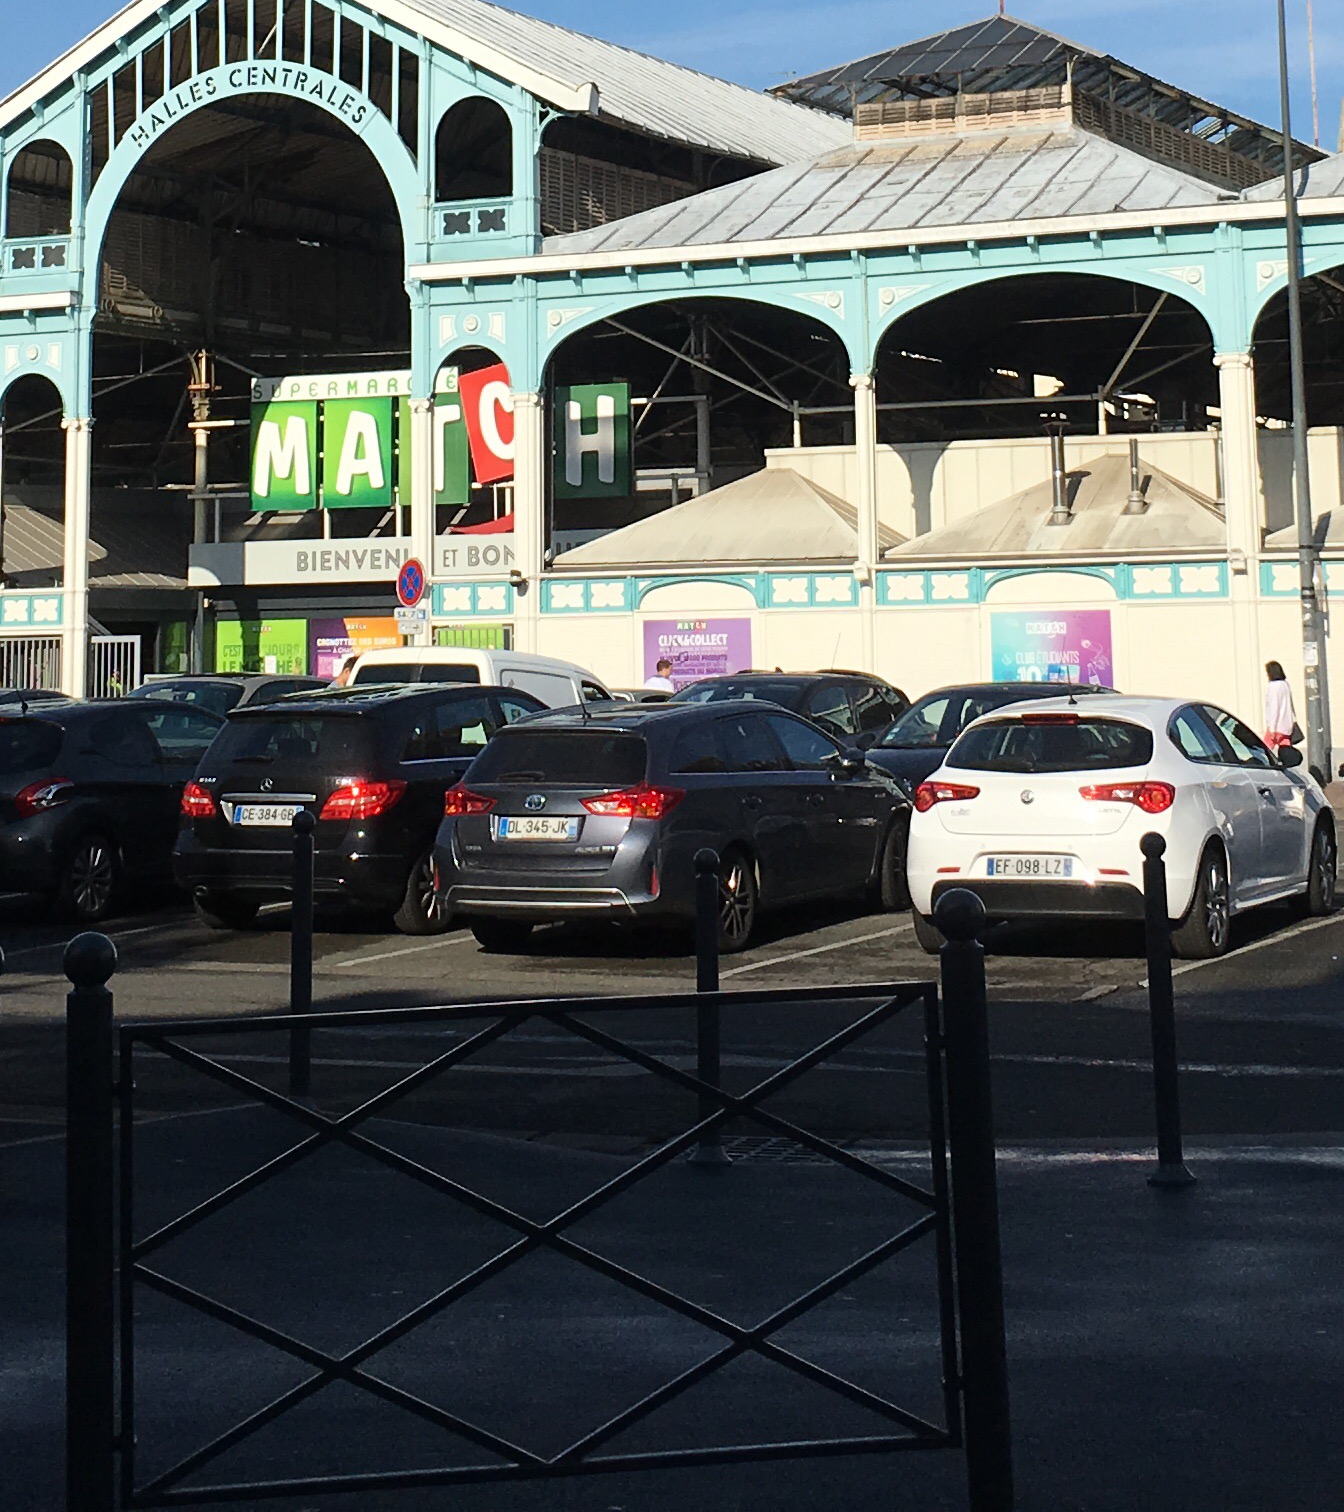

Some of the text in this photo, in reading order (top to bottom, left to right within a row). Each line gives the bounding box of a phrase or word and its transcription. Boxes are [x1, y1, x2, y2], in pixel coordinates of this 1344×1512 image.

[131, 66, 367, 147] HALLES CENTRALES
[253, 366, 457, 400] SUPERMARÉ
[253, 380, 615, 497] MATCH
[443, 549, 458, 568] ET
[677, 621, 707, 630] MATCH
[1026, 622, 1067, 634] MATCH
[658, 633, 729, 647] CLICK&COLLECT
[1015, 651, 1036, 664] CLUB
